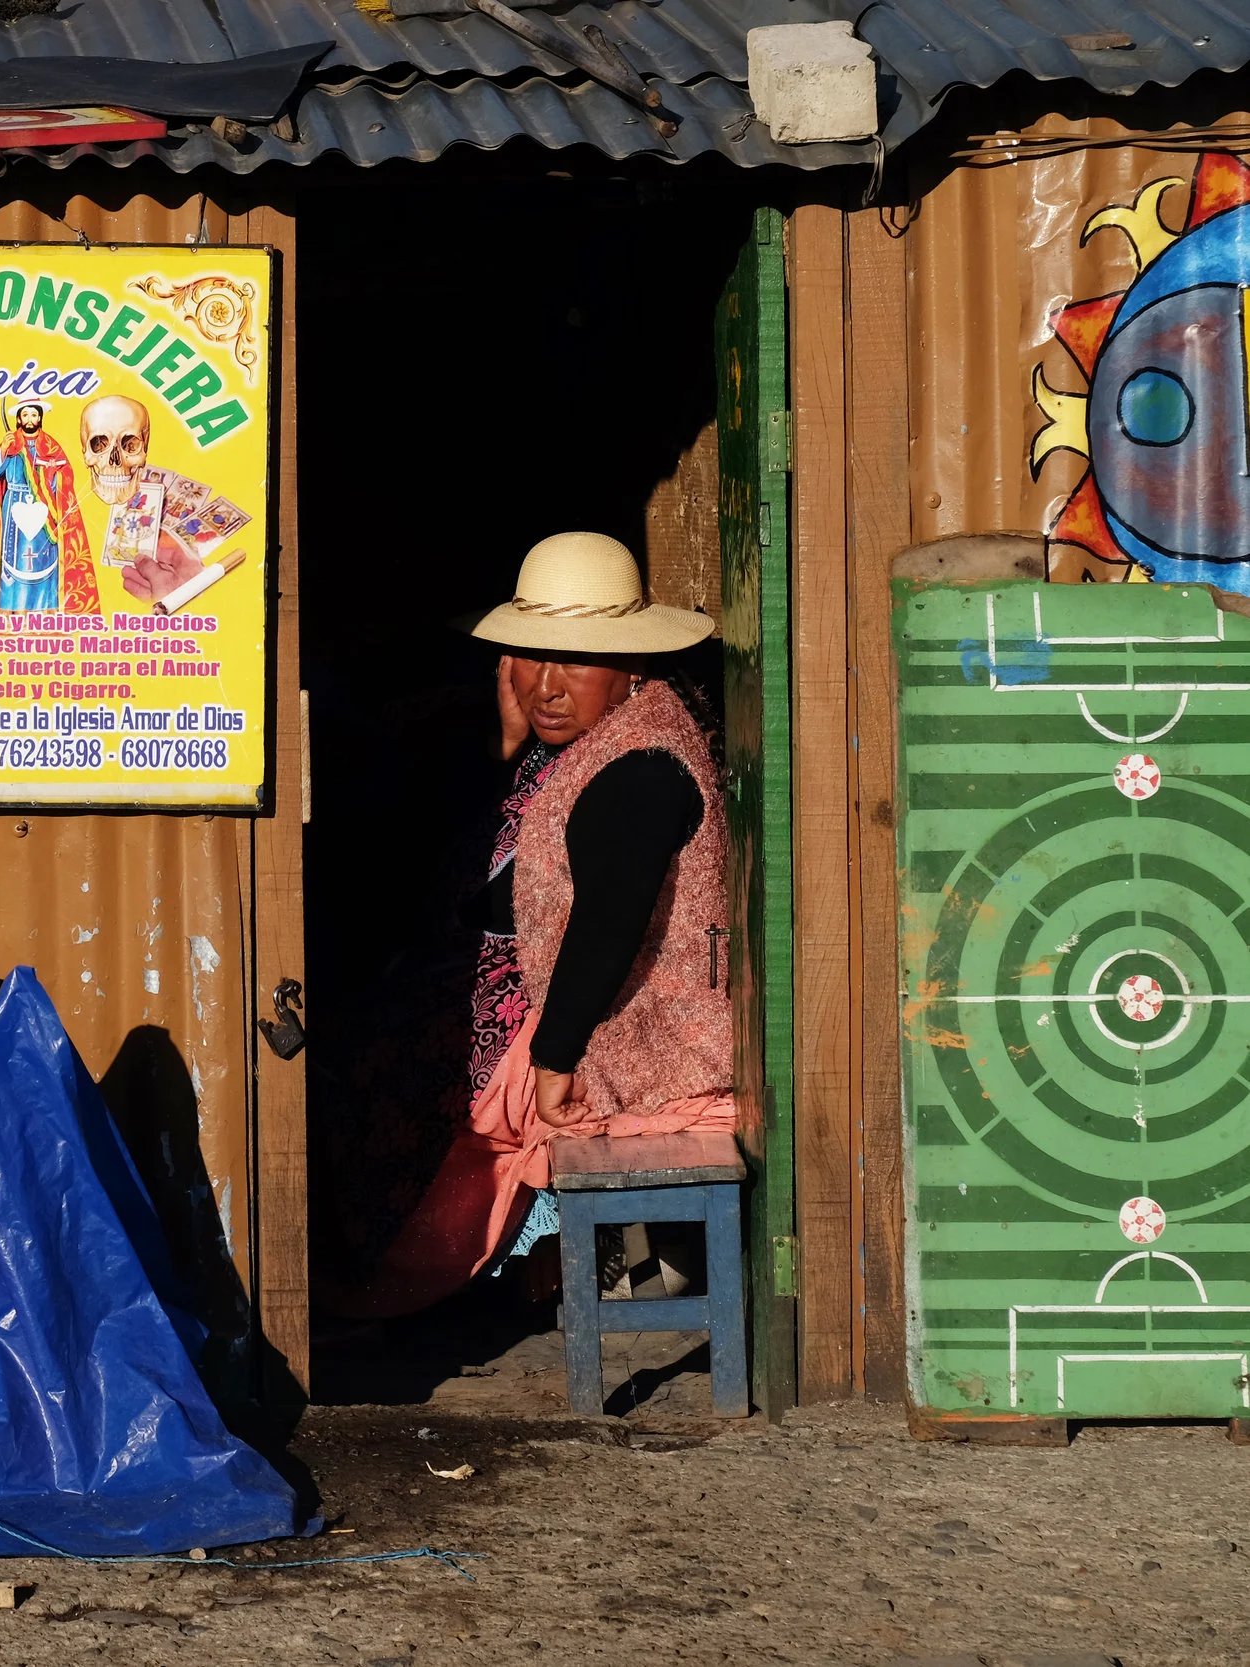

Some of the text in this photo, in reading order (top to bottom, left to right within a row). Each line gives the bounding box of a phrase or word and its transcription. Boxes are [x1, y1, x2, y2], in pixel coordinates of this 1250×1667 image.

[10, 616, 23, 633] y
[28, 614, 108, 632] Naipes,
[114, 613, 217, 632] Negocios
[79, 636, 201, 654] Maleficios.
[8, 658, 76, 676] fuerte
[81, 661, 131, 678] para
[136, 659, 157, 676] el
[162, 659, 221, 677] Amor
[31, 685, 43, 700] y
[49, 681, 137, 700] Cigarro.
[16, 711, 28, 730] a
[33, 706, 49, 730] la
[55, 706, 115, 737] Iglesia
[121, 706, 171, 731] Amor
[176, 706, 199, 731] de
[204, 706, 243, 731] Dios
[121, 739, 227, 768] 68078668
